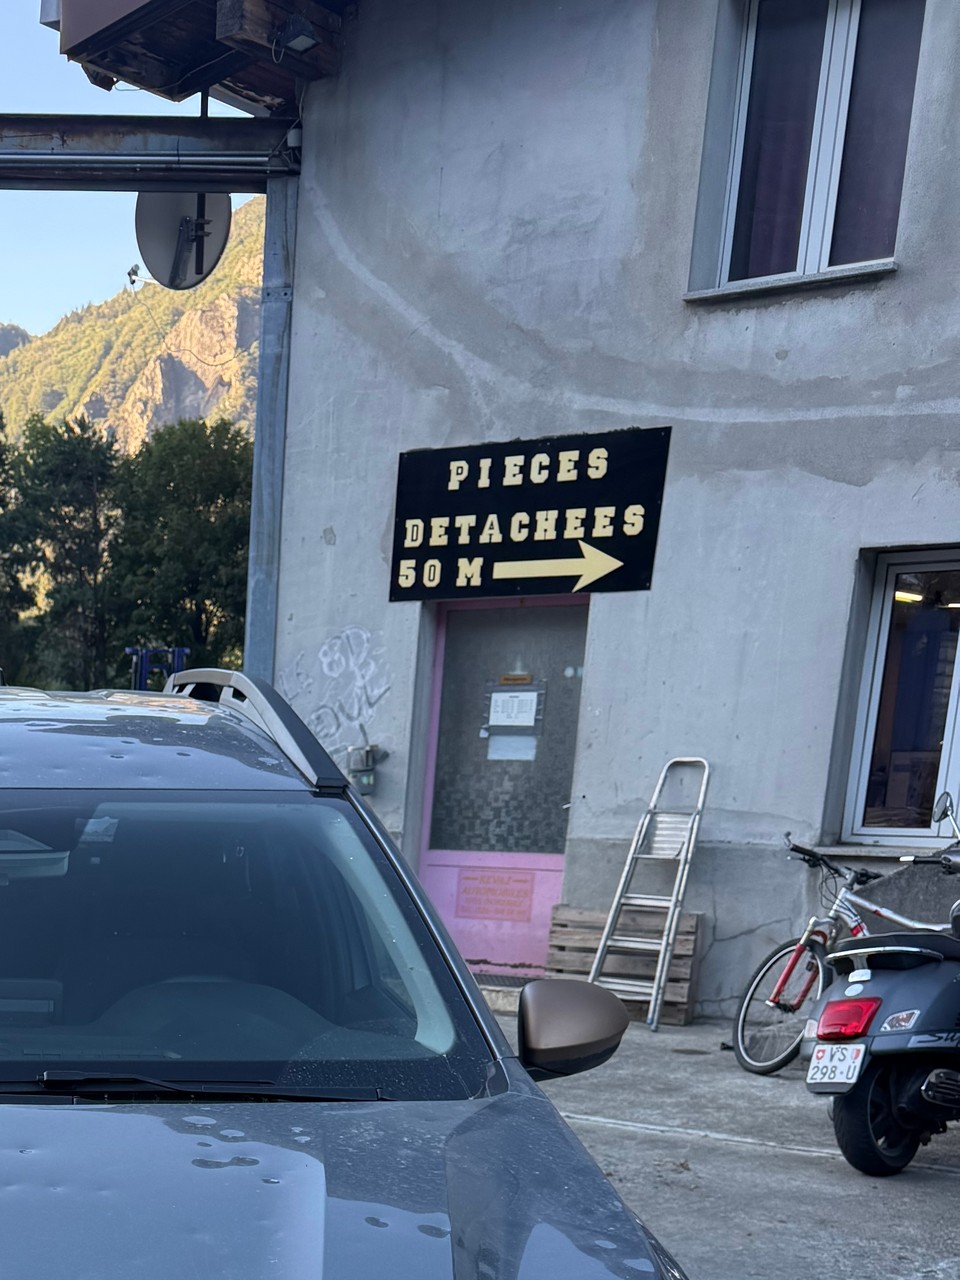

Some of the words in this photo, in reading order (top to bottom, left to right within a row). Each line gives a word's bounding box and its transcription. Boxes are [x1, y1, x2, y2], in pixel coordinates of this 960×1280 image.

[448, 448, 608, 491] PIECES
[404, 504, 645, 548] DETACHEES
[398, 559, 441, 588] 50
[456, 557, 484, 587] M
[830, 1046, 848, 1062] VS
